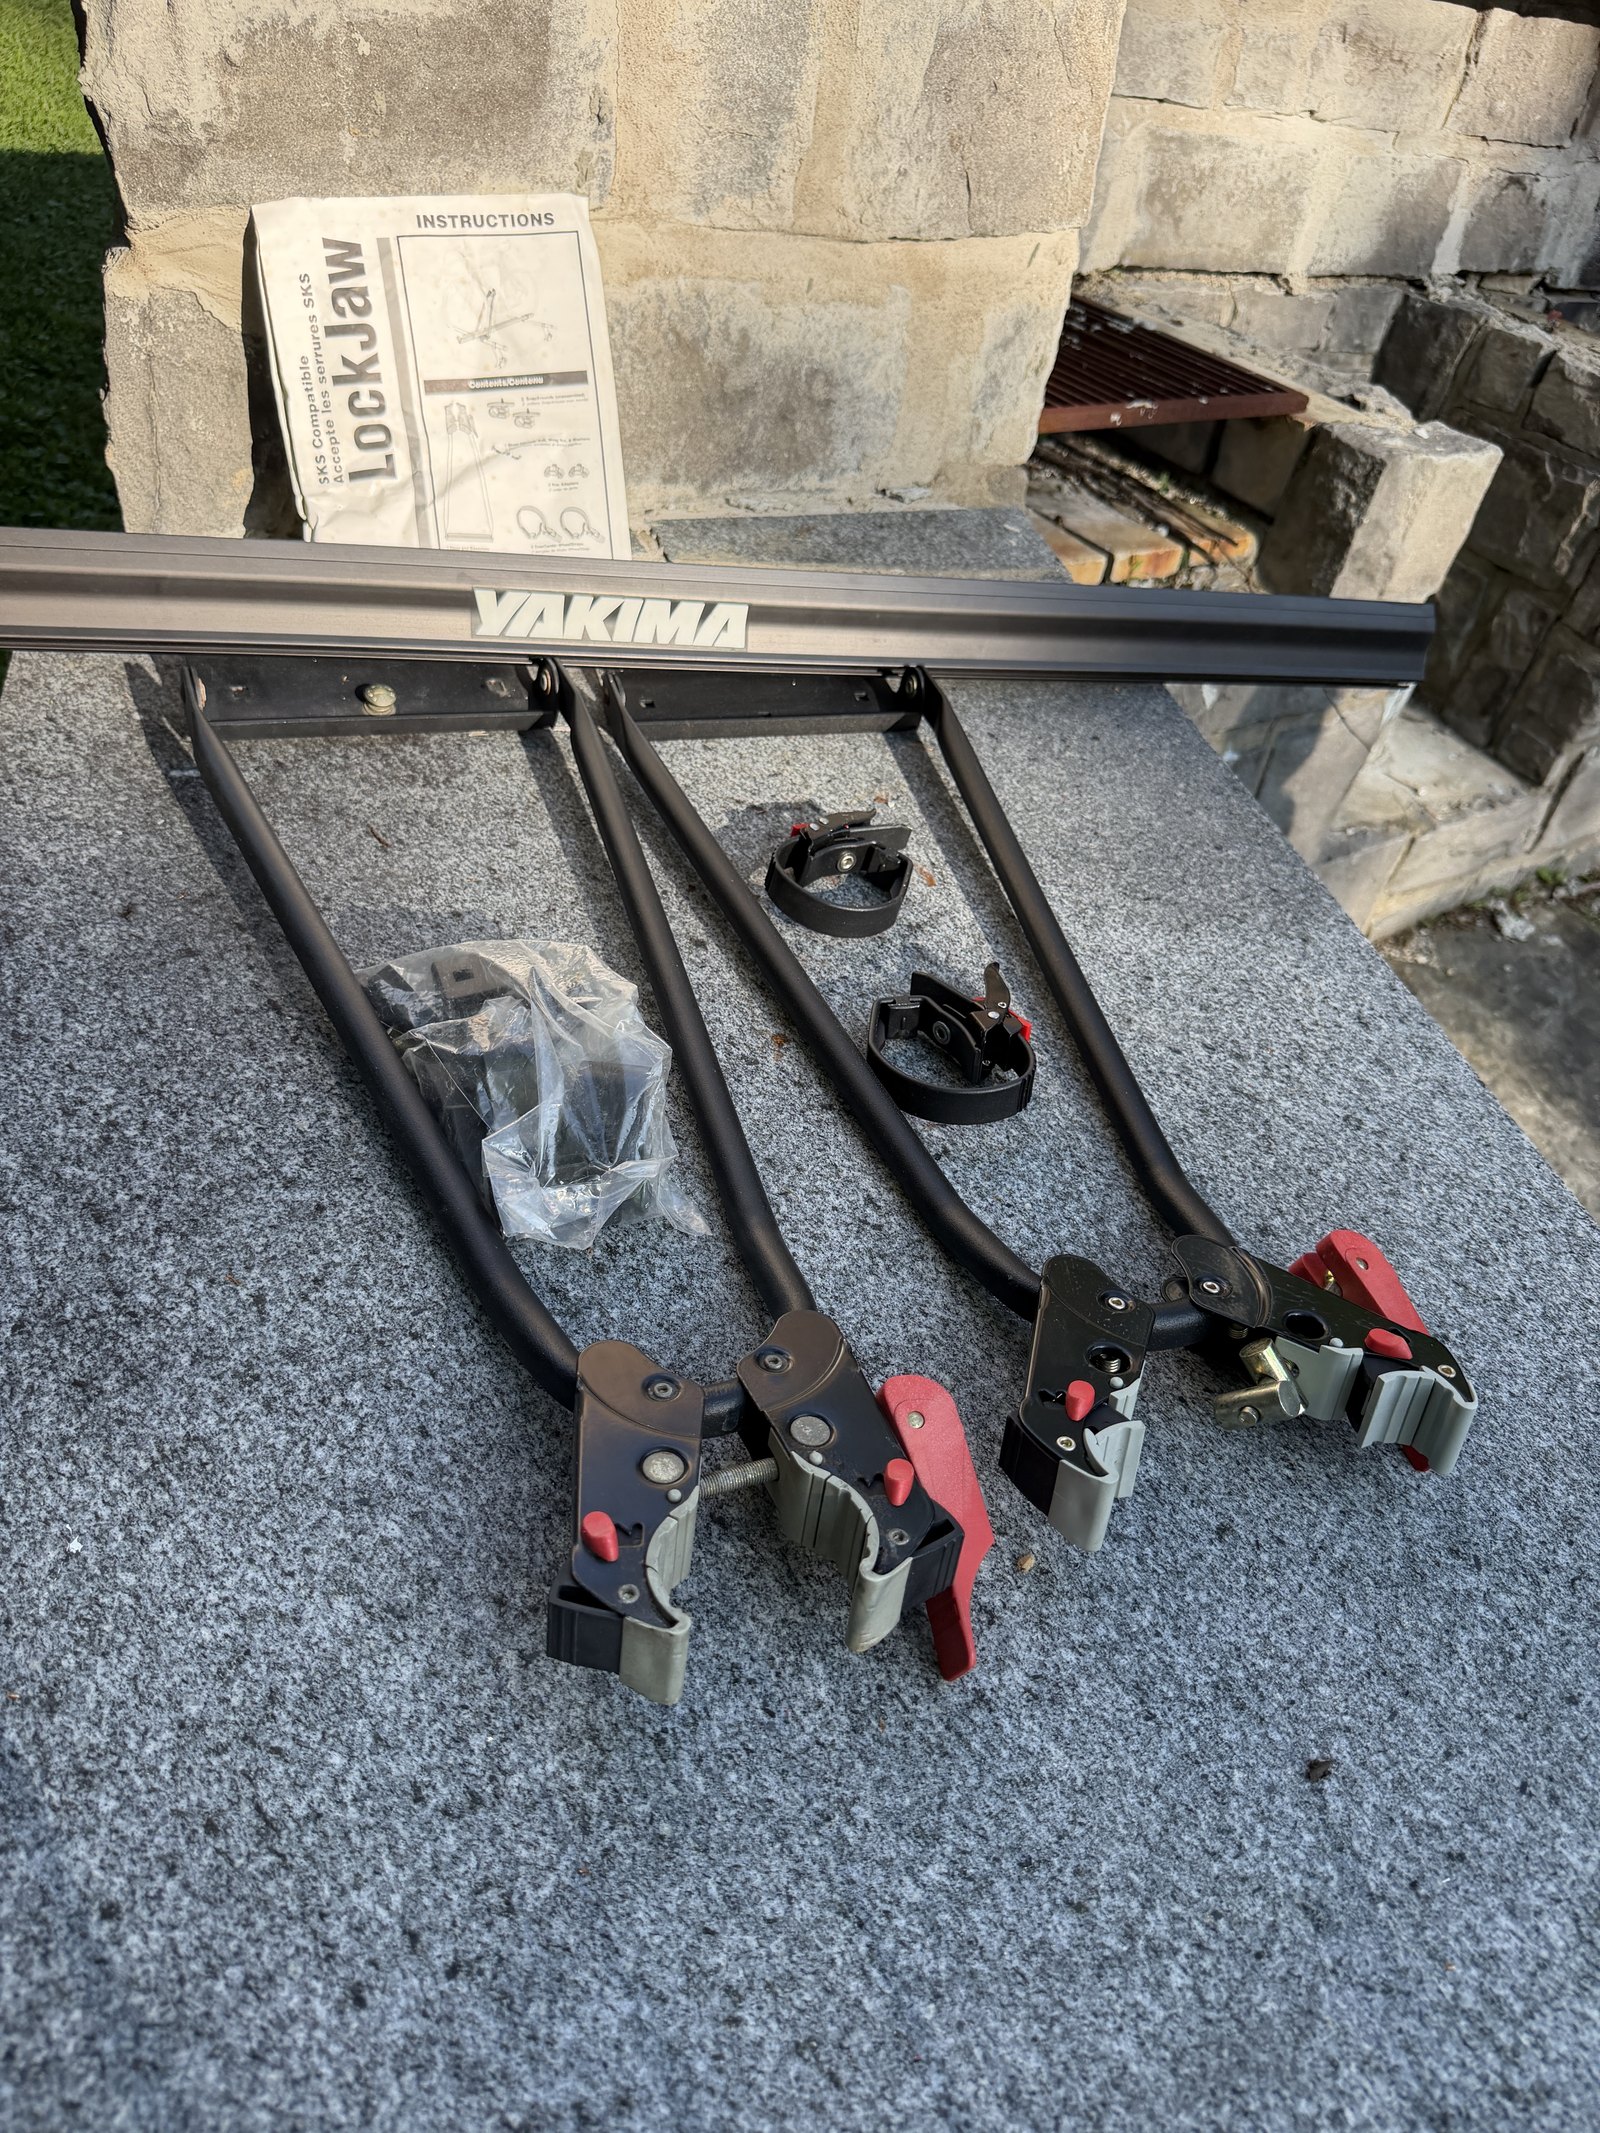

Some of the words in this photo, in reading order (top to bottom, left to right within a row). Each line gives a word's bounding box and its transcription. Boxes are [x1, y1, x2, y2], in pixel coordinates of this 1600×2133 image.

[416, 212, 555, 229] INSTRUCTIONS
[299, 273, 315, 309] SKS
[308, 314, 326, 384] serrures
[322, 237, 397, 483] LockJaw
[299, 355, 322, 449] Compatible
[321, 390, 332, 415] les
[314, 454, 330, 485] SKS
[326, 418, 344, 484] Accepte
[473, 588, 749, 649] YAKIMA
